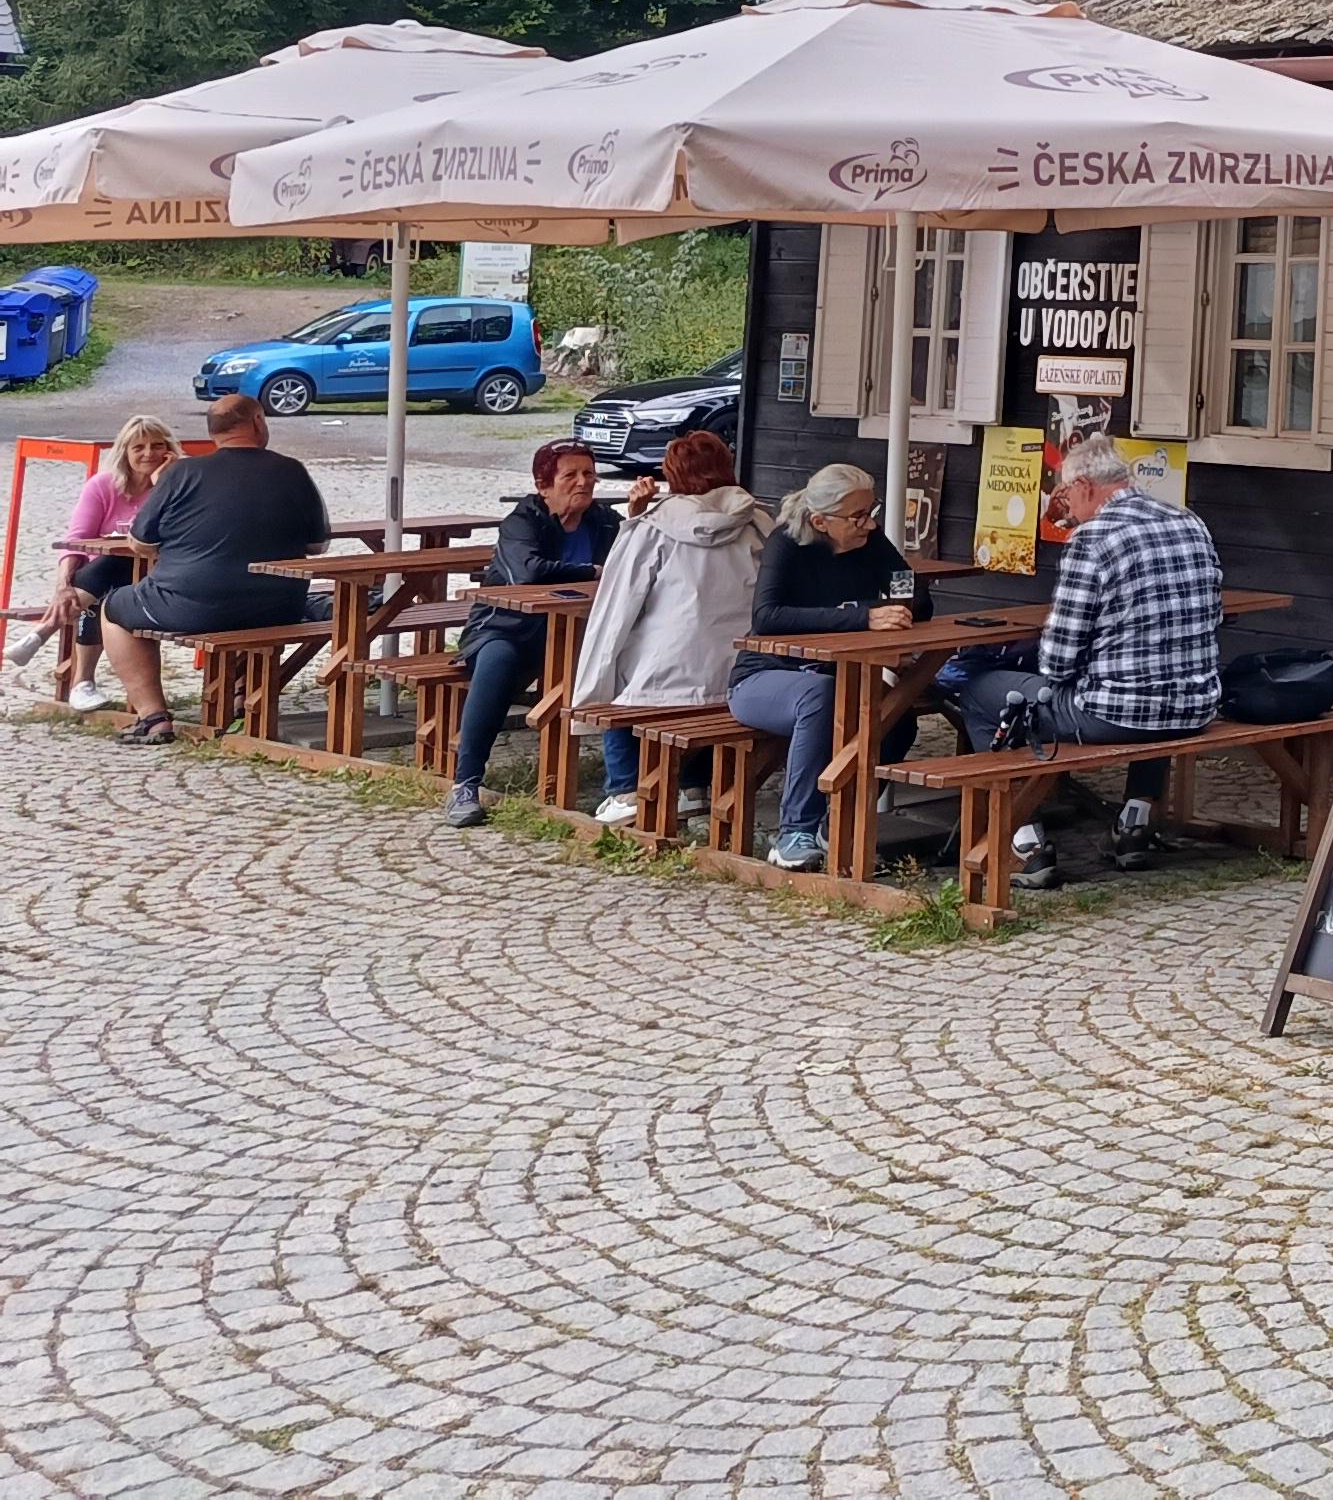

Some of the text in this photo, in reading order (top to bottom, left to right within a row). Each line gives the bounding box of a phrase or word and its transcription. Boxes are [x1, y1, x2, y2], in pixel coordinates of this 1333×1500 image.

[1050, 72, 1184, 97] Prima
[360, 141, 518, 192] ČESKÁ ZMRZLINA
[577, 156, 608, 176] Prima
[851, 163, 913, 184] Prima
[1033, 142, 1155, 187] ČESKÁ
[280, 178, 306, 198] Prima
[1017, 258, 1139, 302] OBČERSTVE
[1020, 306, 1137, 350] U VODOPÁD
[1083, 369, 1124, 385] OPLATKY
[990, 463, 1031, 479] JESENICKÁ
[1137, 463, 1164, 477] Prima
